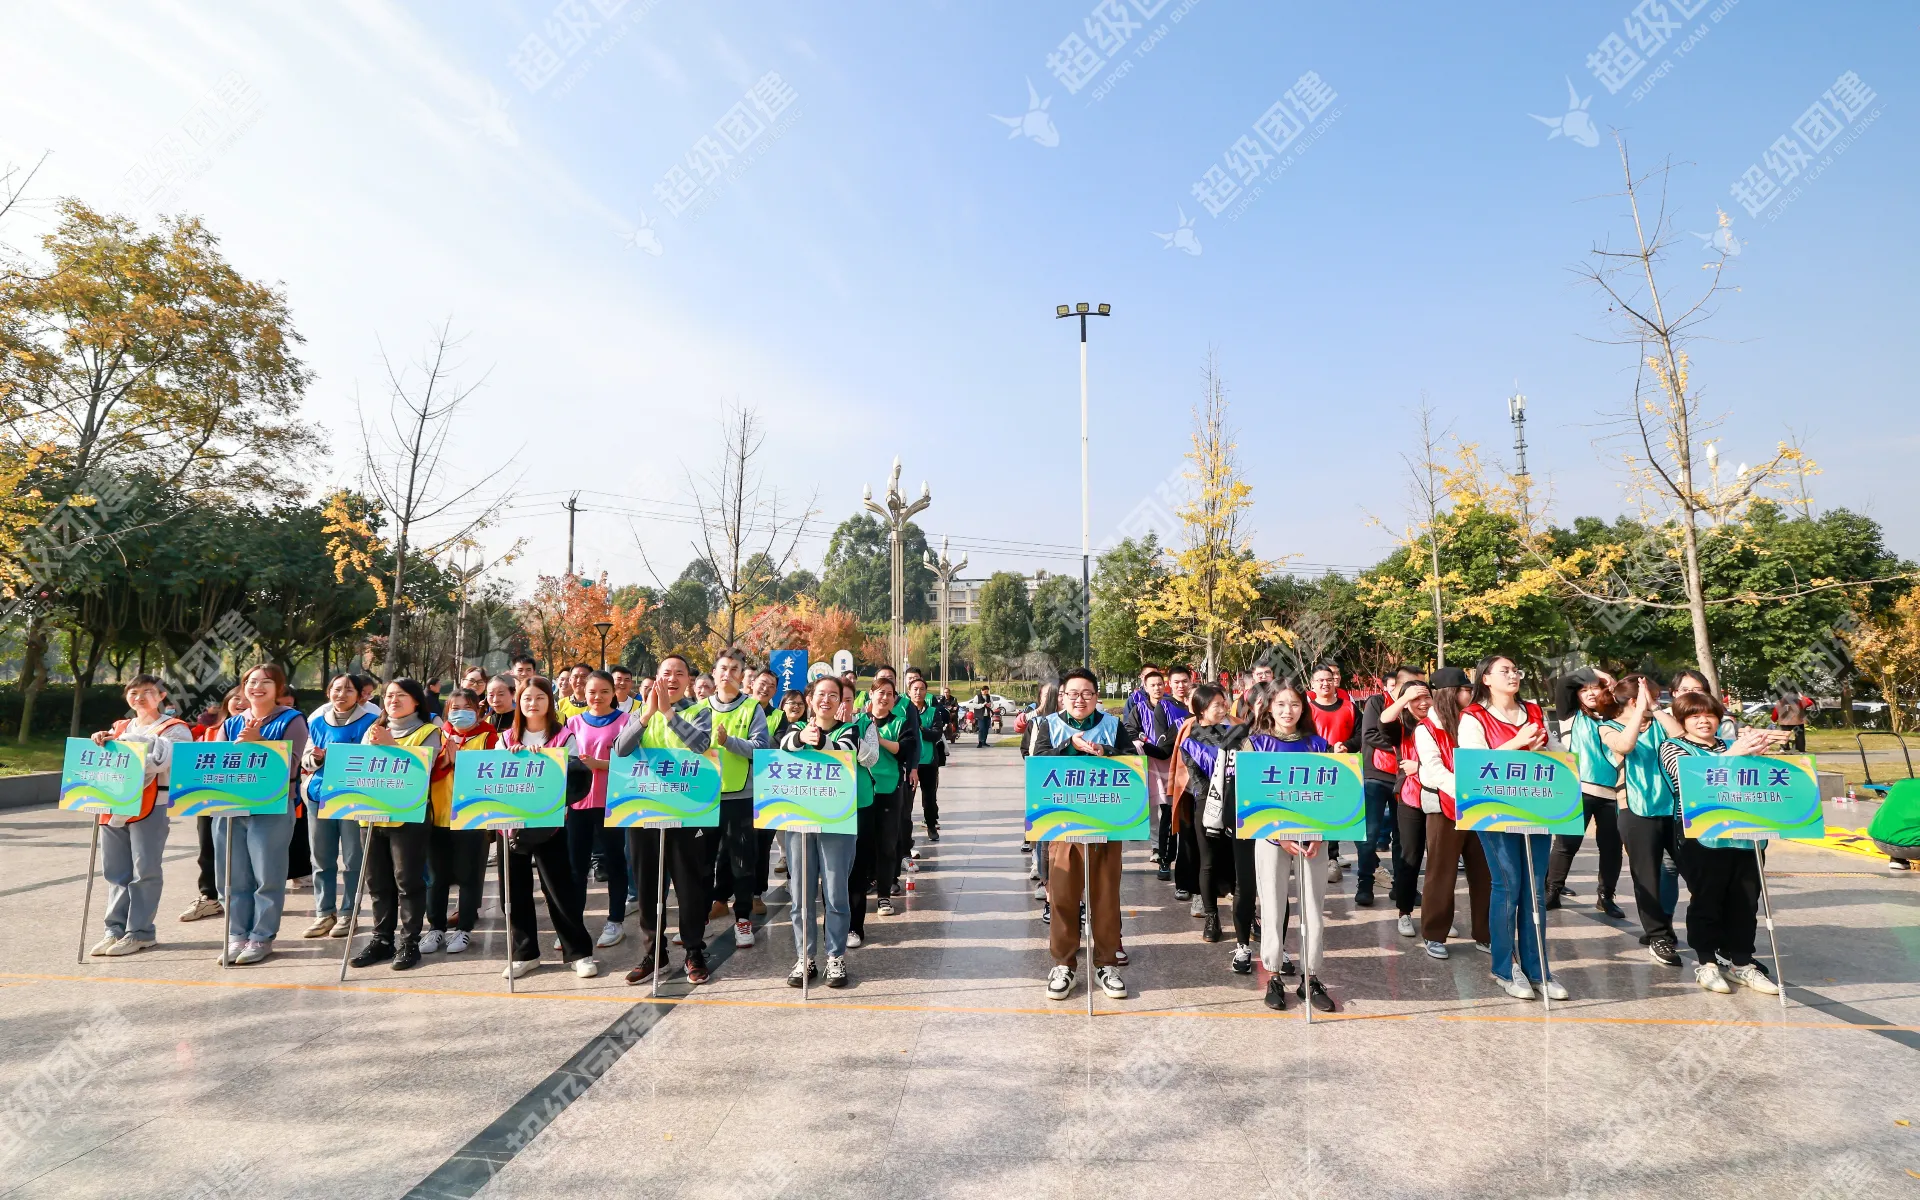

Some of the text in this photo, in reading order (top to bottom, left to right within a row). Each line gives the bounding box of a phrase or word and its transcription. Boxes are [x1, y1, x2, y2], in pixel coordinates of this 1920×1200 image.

[79, 750, 130, 769] 红光村
[194, 752, 269, 770] 洪福村
[345, 756, 411, 774] 三村村
[630, 759, 700, 777] 永丰村
[476, 760, 545, 779] 长伍村
[767, 761, 842, 781] 文安社区
[1042, 769, 1131, 788] 人和社区
[1260, 765, 1339, 786] 土门村
[1478, 762, 1556, 782] 大同村
[1706, 767, 1791, 787] 镇机关
